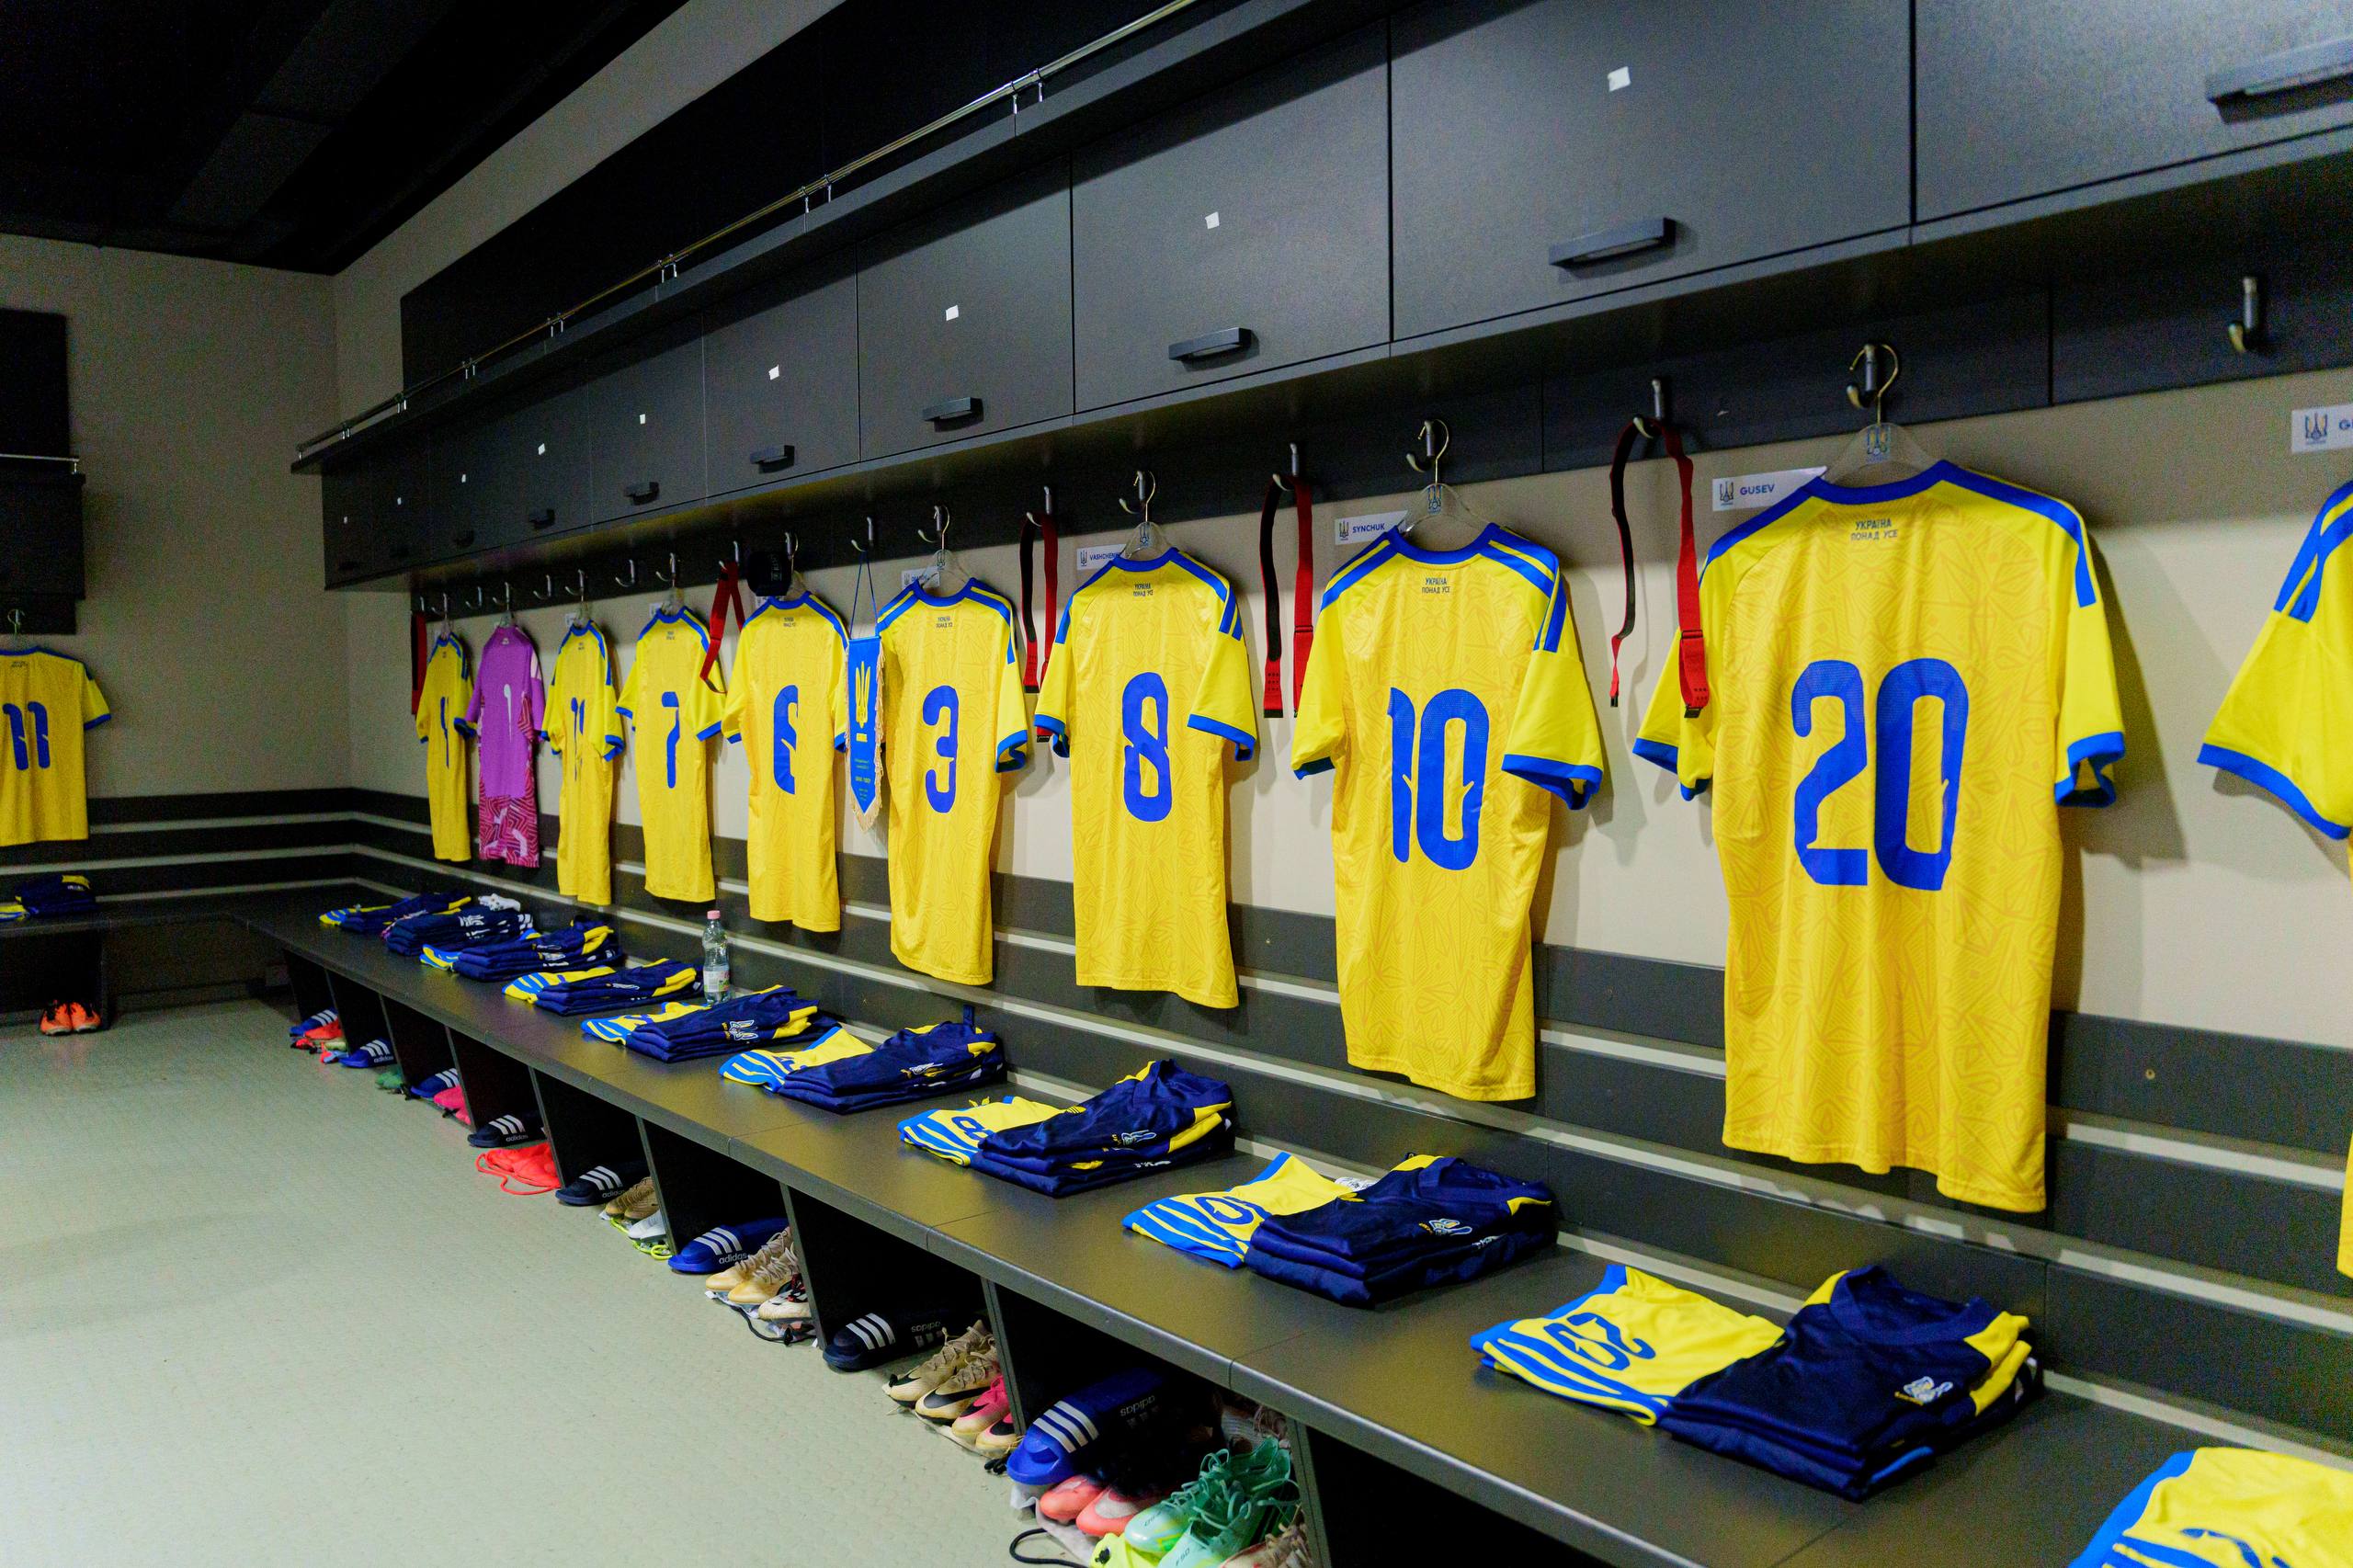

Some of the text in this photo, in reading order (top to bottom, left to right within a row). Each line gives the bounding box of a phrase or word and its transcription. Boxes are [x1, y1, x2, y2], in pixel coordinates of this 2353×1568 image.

[1740, 483, 1775, 495] GUSEV
[1352, 523, 1385, 533] SYNCHUK
[2, 701, 51, 771] 11
[774, 684, 799, 795] 6
[923, 685, 959, 813] 3
[1122, 672, 1173, 823] 8
[1387, 687, 1490, 871] 10
[1791, 657, 1969, 891] 20
[602, 1189, 625, 1199] adida
[719, 1252, 747, 1265] adidas
[911, 1321, 941, 1333] adidas
[1543, 1312, 1656, 1371] 20
[1120, 1395, 1155, 1416] adidas
